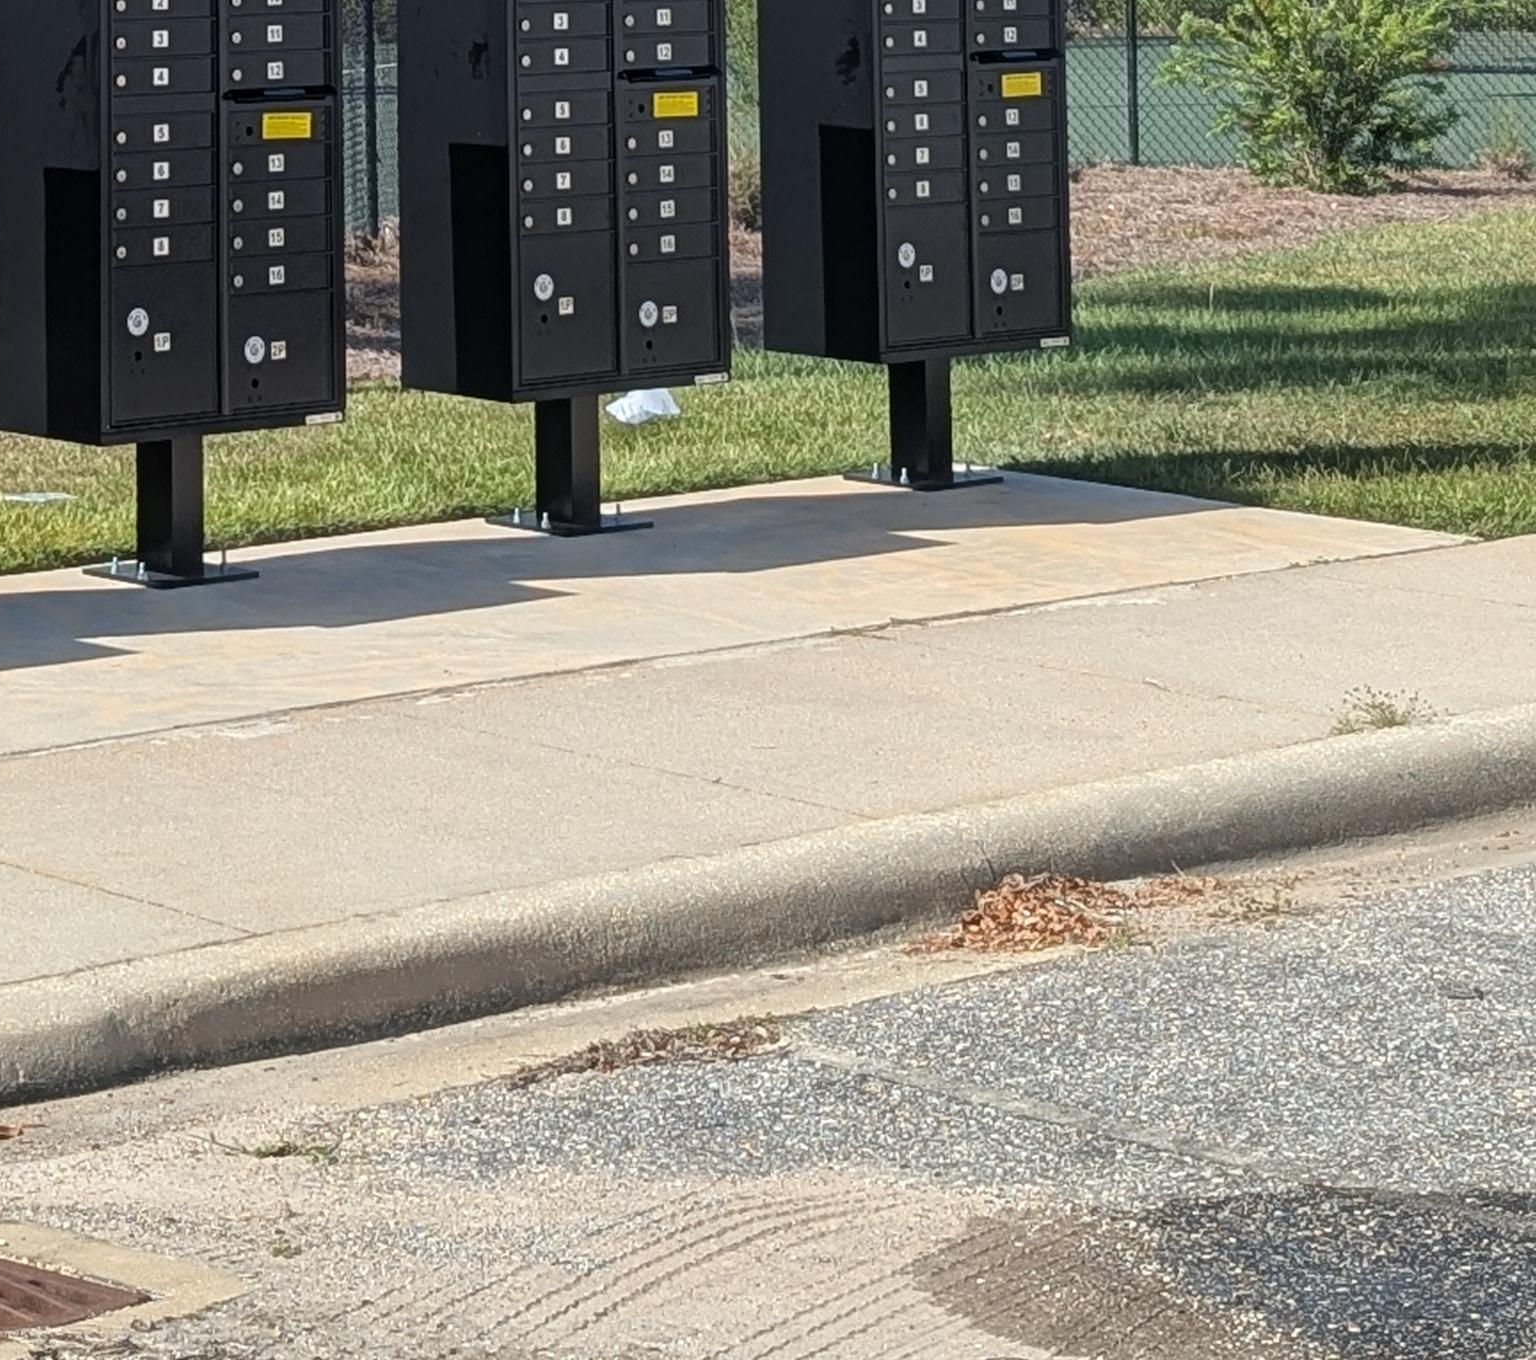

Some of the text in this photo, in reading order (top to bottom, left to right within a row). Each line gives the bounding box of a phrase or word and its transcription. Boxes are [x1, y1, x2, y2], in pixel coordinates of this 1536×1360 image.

[157, 33, 164, 45] 3
[270, 28, 280, 39] 11
[270, 64, 281, 76] 12
[157, 71, 164, 82] 4
[158, 126, 165, 140] 5
[271, 157, 282, 168] 13
[157, 164, 165, 177] 6
[271, 194, 282, 206] 14
[158, 202, 165, 214] 7
[271, 231, 283, 243] 15
[158, 240, 164, 252] 8
[271, 268, 283, 280] 16
